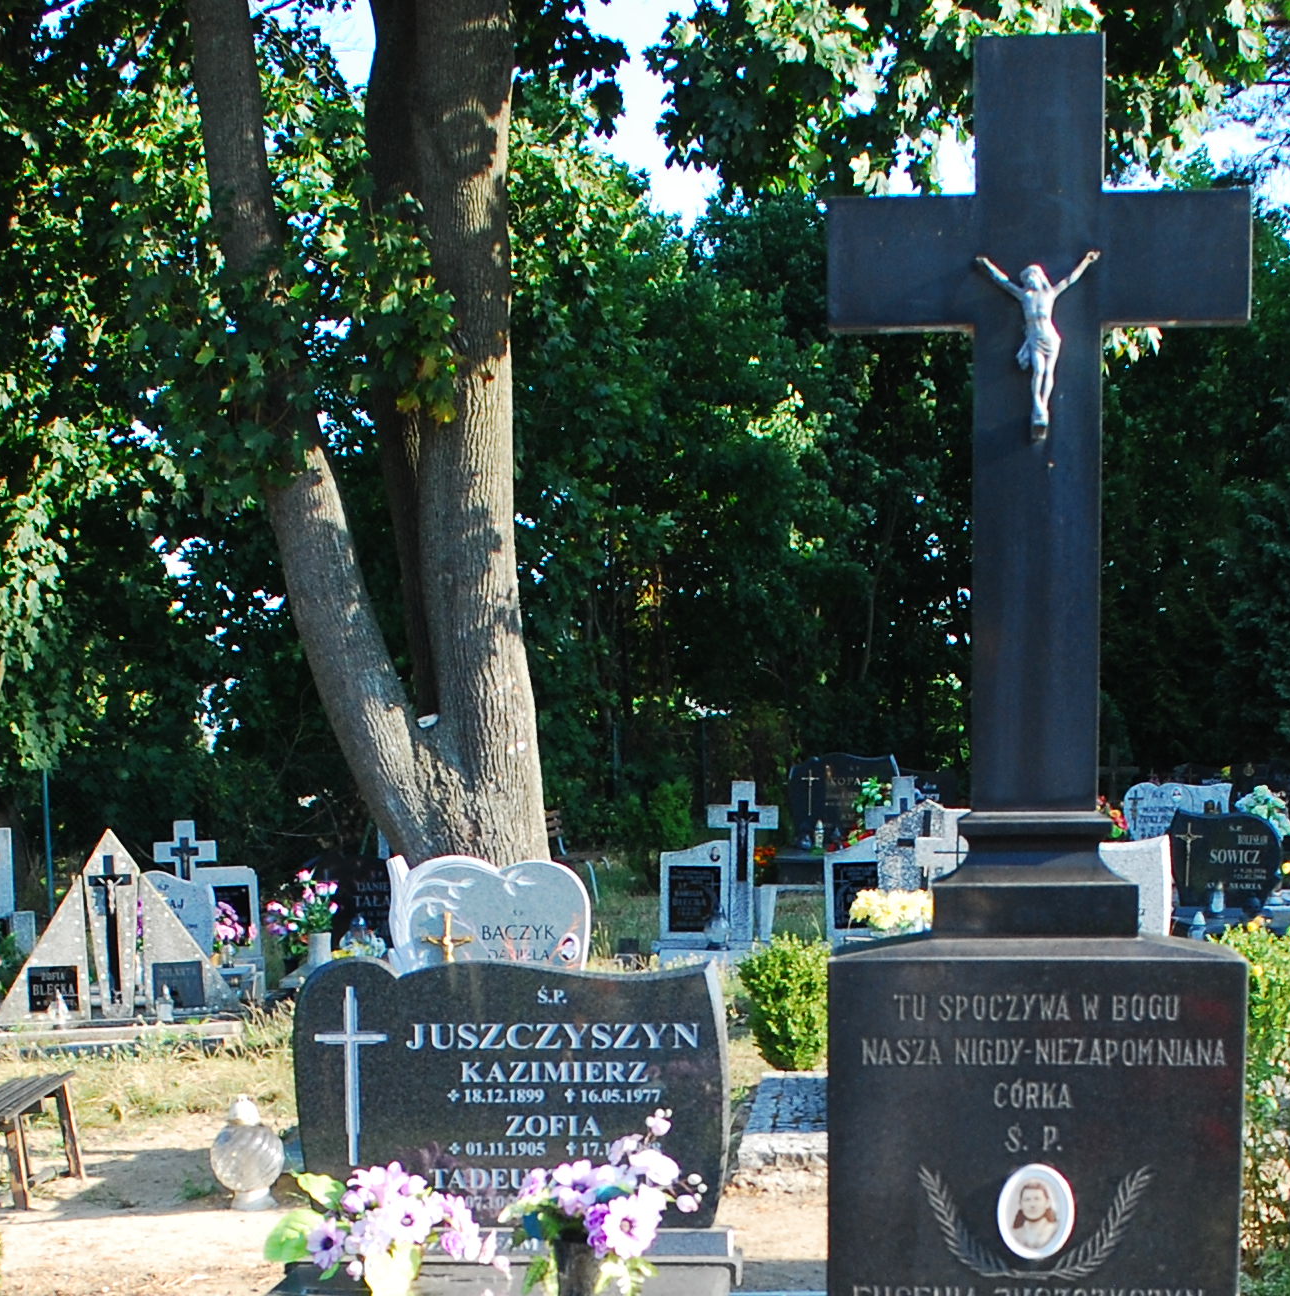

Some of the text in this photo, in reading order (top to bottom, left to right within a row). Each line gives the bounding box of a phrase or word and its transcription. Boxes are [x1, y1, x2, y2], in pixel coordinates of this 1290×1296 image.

[1209, 849, 1260, 865] SOWICZ
[893, 993, 1180, 1022] TU SPOCZYWA W BOGU
[405, 1022, 701, 1051] JUSZCZYSZYN
[860, 1037, 943, 1067] NASZA
[459, 1060, 650, 1084] KAZIMIERZ
[463, 1088, 662, 1104] 18.12.1899 16.05.1977
[993, 1077, 1075, 1109] CÓRKA
[505, 1114, 603, 1138] ZOFIA
[464, 1141, 547, 1157] 01.11.1905
